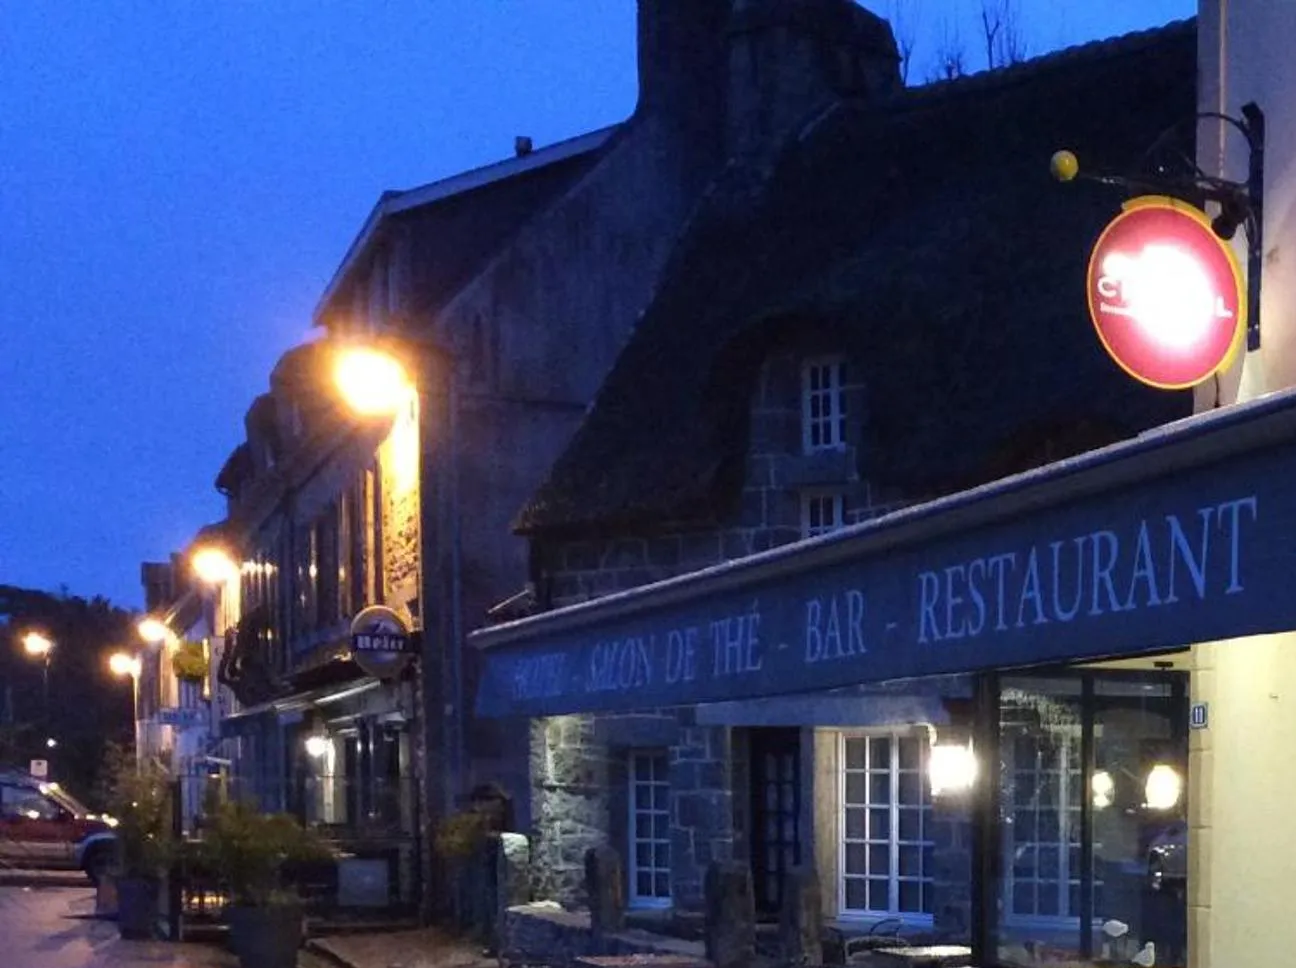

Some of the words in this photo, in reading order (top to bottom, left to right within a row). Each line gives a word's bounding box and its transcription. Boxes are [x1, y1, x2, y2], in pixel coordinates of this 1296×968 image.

[665, 626, 698, 683] DE
[710, 598, 763, 676] THÉ
[804, 589, 867, 663] BAR
[916, 496, 1258, 646] RESTAURANT
